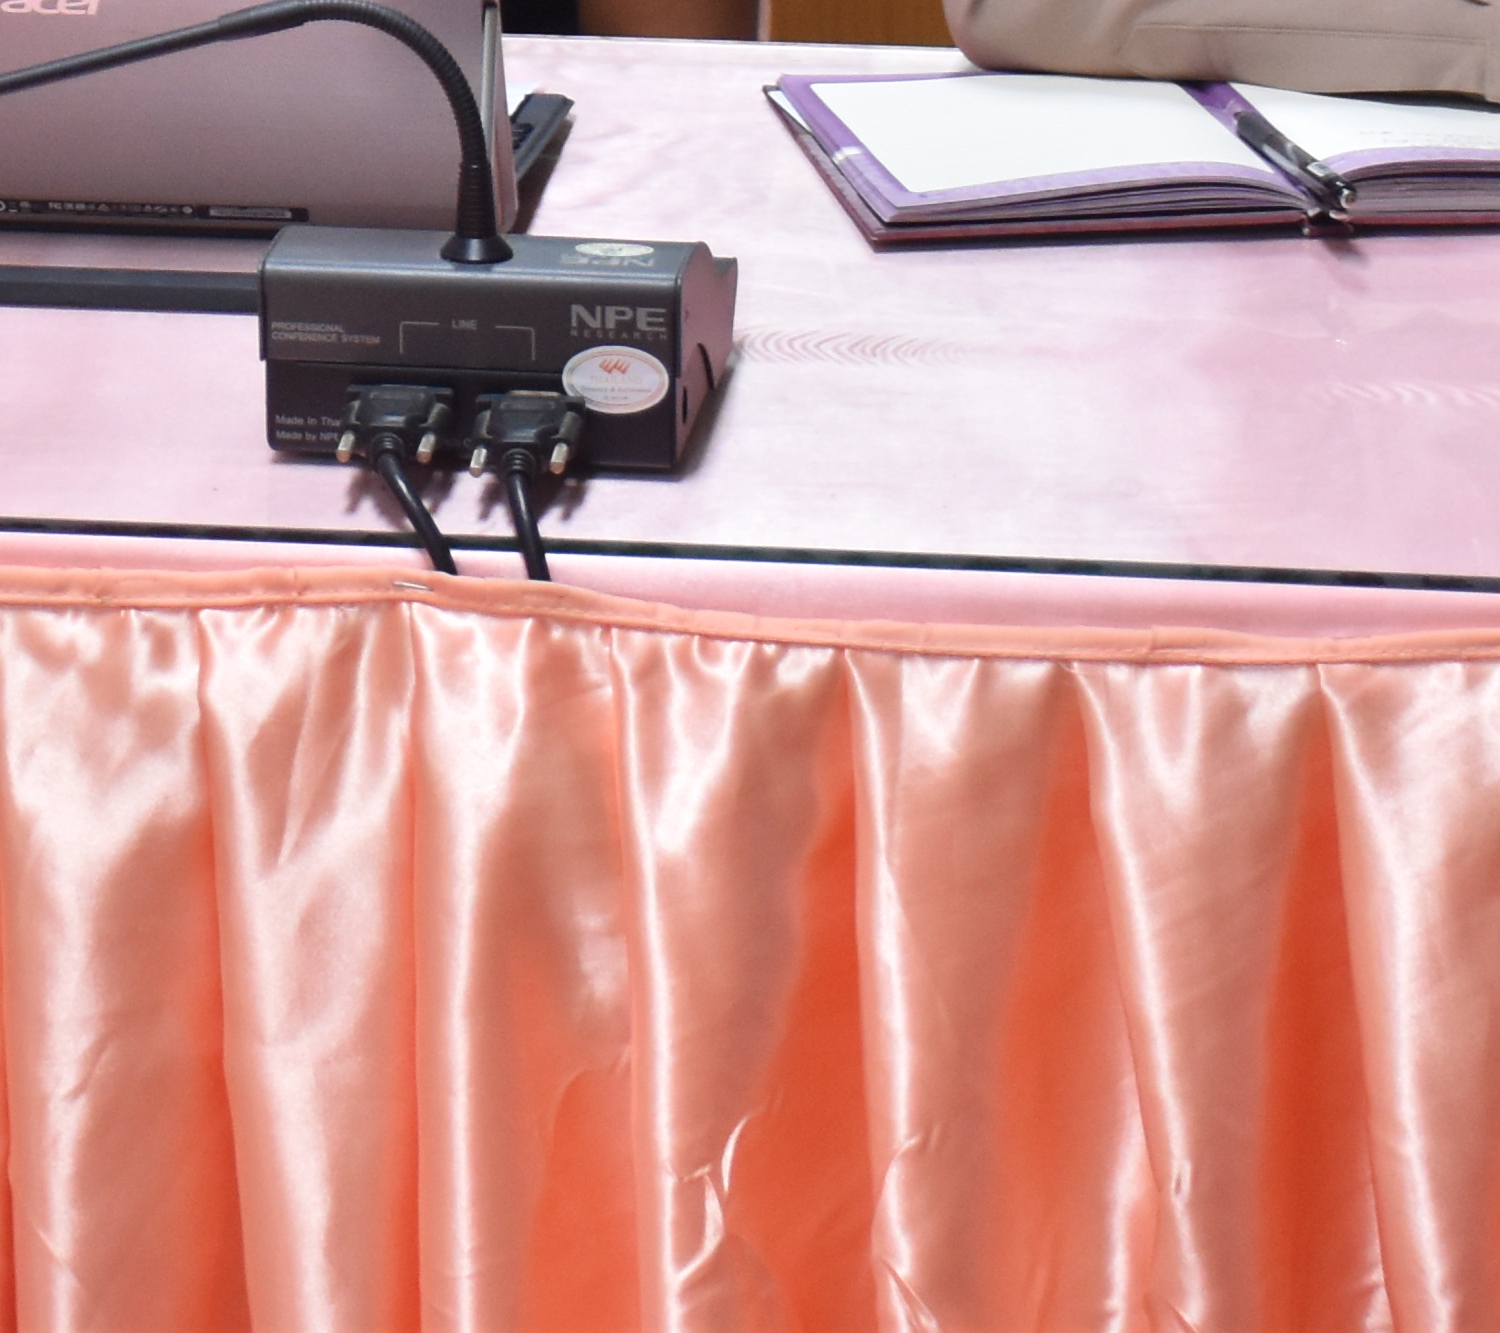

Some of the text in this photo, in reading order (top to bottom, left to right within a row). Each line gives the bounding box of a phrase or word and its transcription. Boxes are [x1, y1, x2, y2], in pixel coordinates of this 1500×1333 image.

[570, 304, 667, 331] NPE
[271, 321, 345, 333] PROFESSIONAL
[451, 318, 478, 331] LINE
[271, 331, 381, 344] CONFERENCE SYSTEM
[276, 414, 304, 426] Made
[276, 430, 302, 440] Made
[304, 431, 317, 442] by
